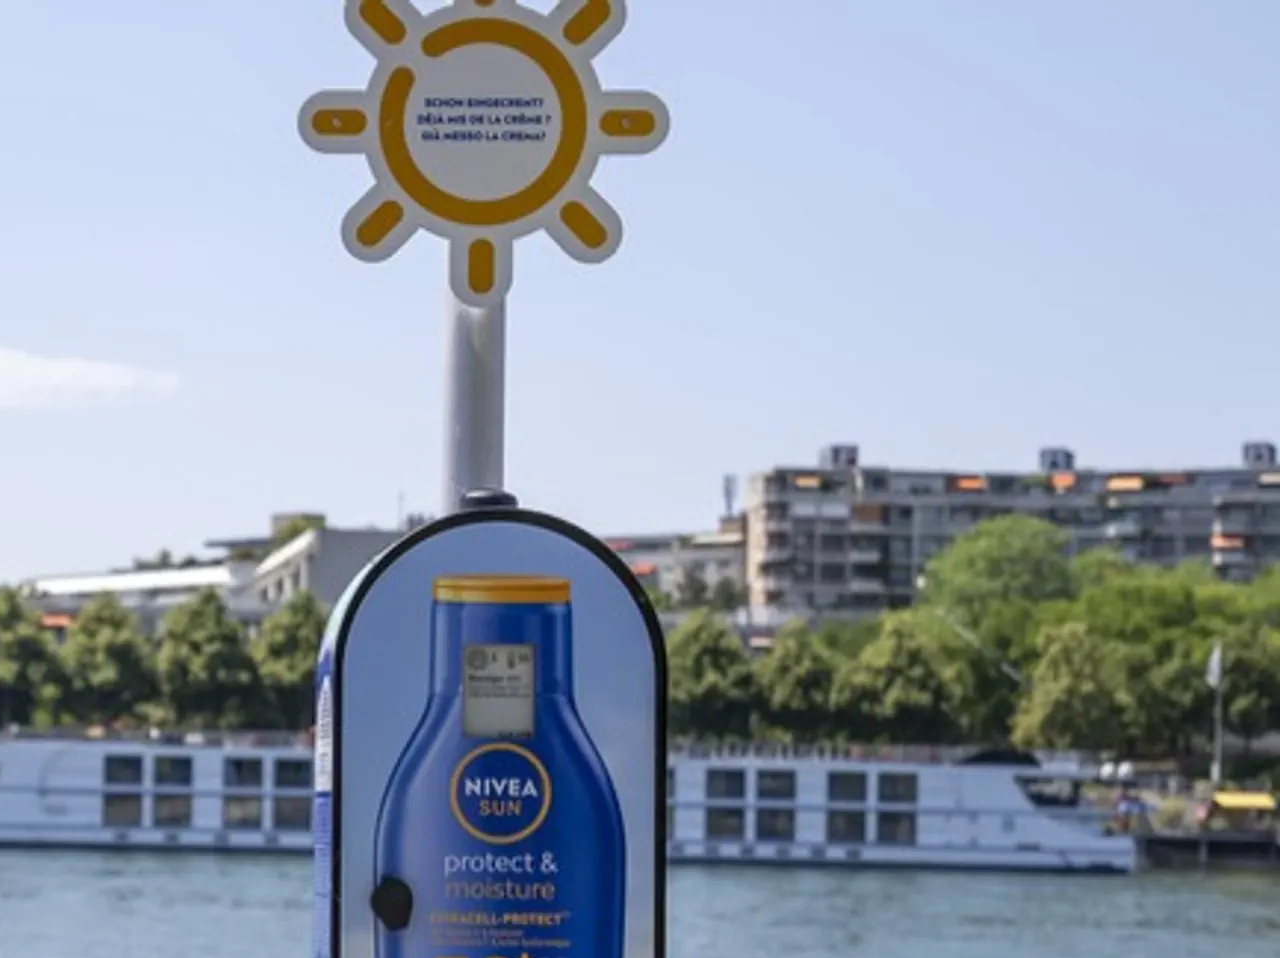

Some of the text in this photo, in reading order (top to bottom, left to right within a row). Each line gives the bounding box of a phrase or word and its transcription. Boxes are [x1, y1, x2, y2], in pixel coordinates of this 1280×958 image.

[464, 777, 538, 798] NIVEA
[479, 800, 521, 817] SUN
[444, 852, 558, 875] protect &
[445, 876, 556, 900] moisture
